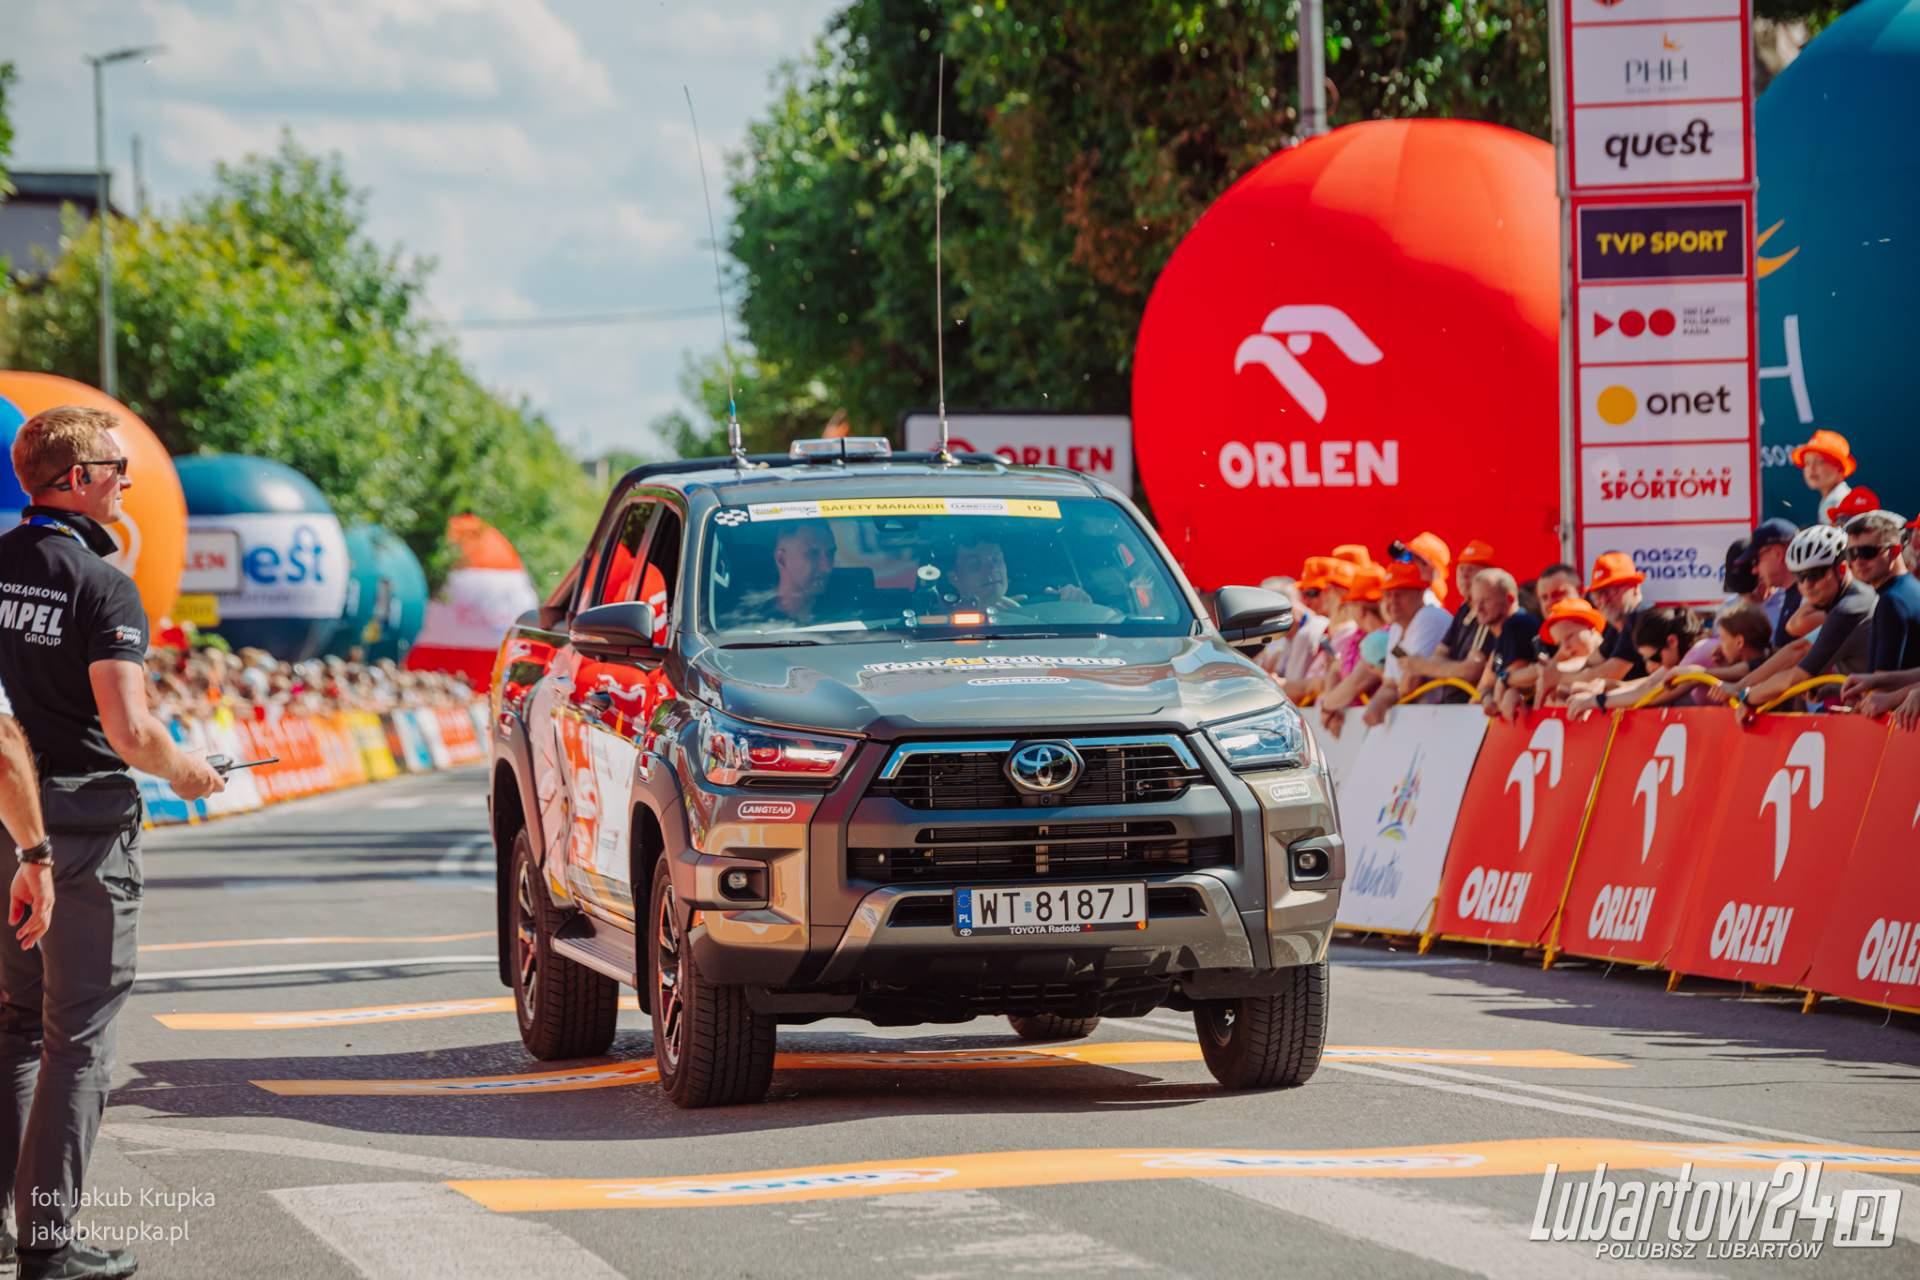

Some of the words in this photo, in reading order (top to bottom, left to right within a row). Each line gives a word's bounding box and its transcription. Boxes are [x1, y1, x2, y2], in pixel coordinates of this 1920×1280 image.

[1625, 58, 1689, 84] PHH
[1604, 118, 1714, 169] quest
[1596, 233, 1645, 255] TVP
[1650, 229, 1728, 254] SPORT
[1646, 385, 1731, 416] onet
[1219, 441, 1399, 487] ORLEN
[1600, 478, 1732, 500] SPORTOWY
[821, 503, 872, 512] SAFETY
[876, 502, 946, 511] MANAGER
[1026, 504, 1042, 512] 10
[242, 524, 325, 584] est
[1632, 547, 1698, 563] nasze
[1636, 562, 1727, 582] miasto.p
[0, 599, 63, 637] MPEL
[24, 632, 62, 647] GROUP
[742, 805, 792, 814] LANGTEAM
[979, 892, 1021, 924] WT
[1036, 887, 1134, 922] 8187J
[1457, 865, 1533, 924] ORLEN
[959, 914, 971, 923] PL
[1587, 883, 1657, 943] ORLEN
[1009, 926, 1046, 935] TOYOTA
[1048, 923, 1081, 933] Radość
[1709, 900, 1795, 966] ORLEN
[1857, 917, 1920, 986] ORLE
